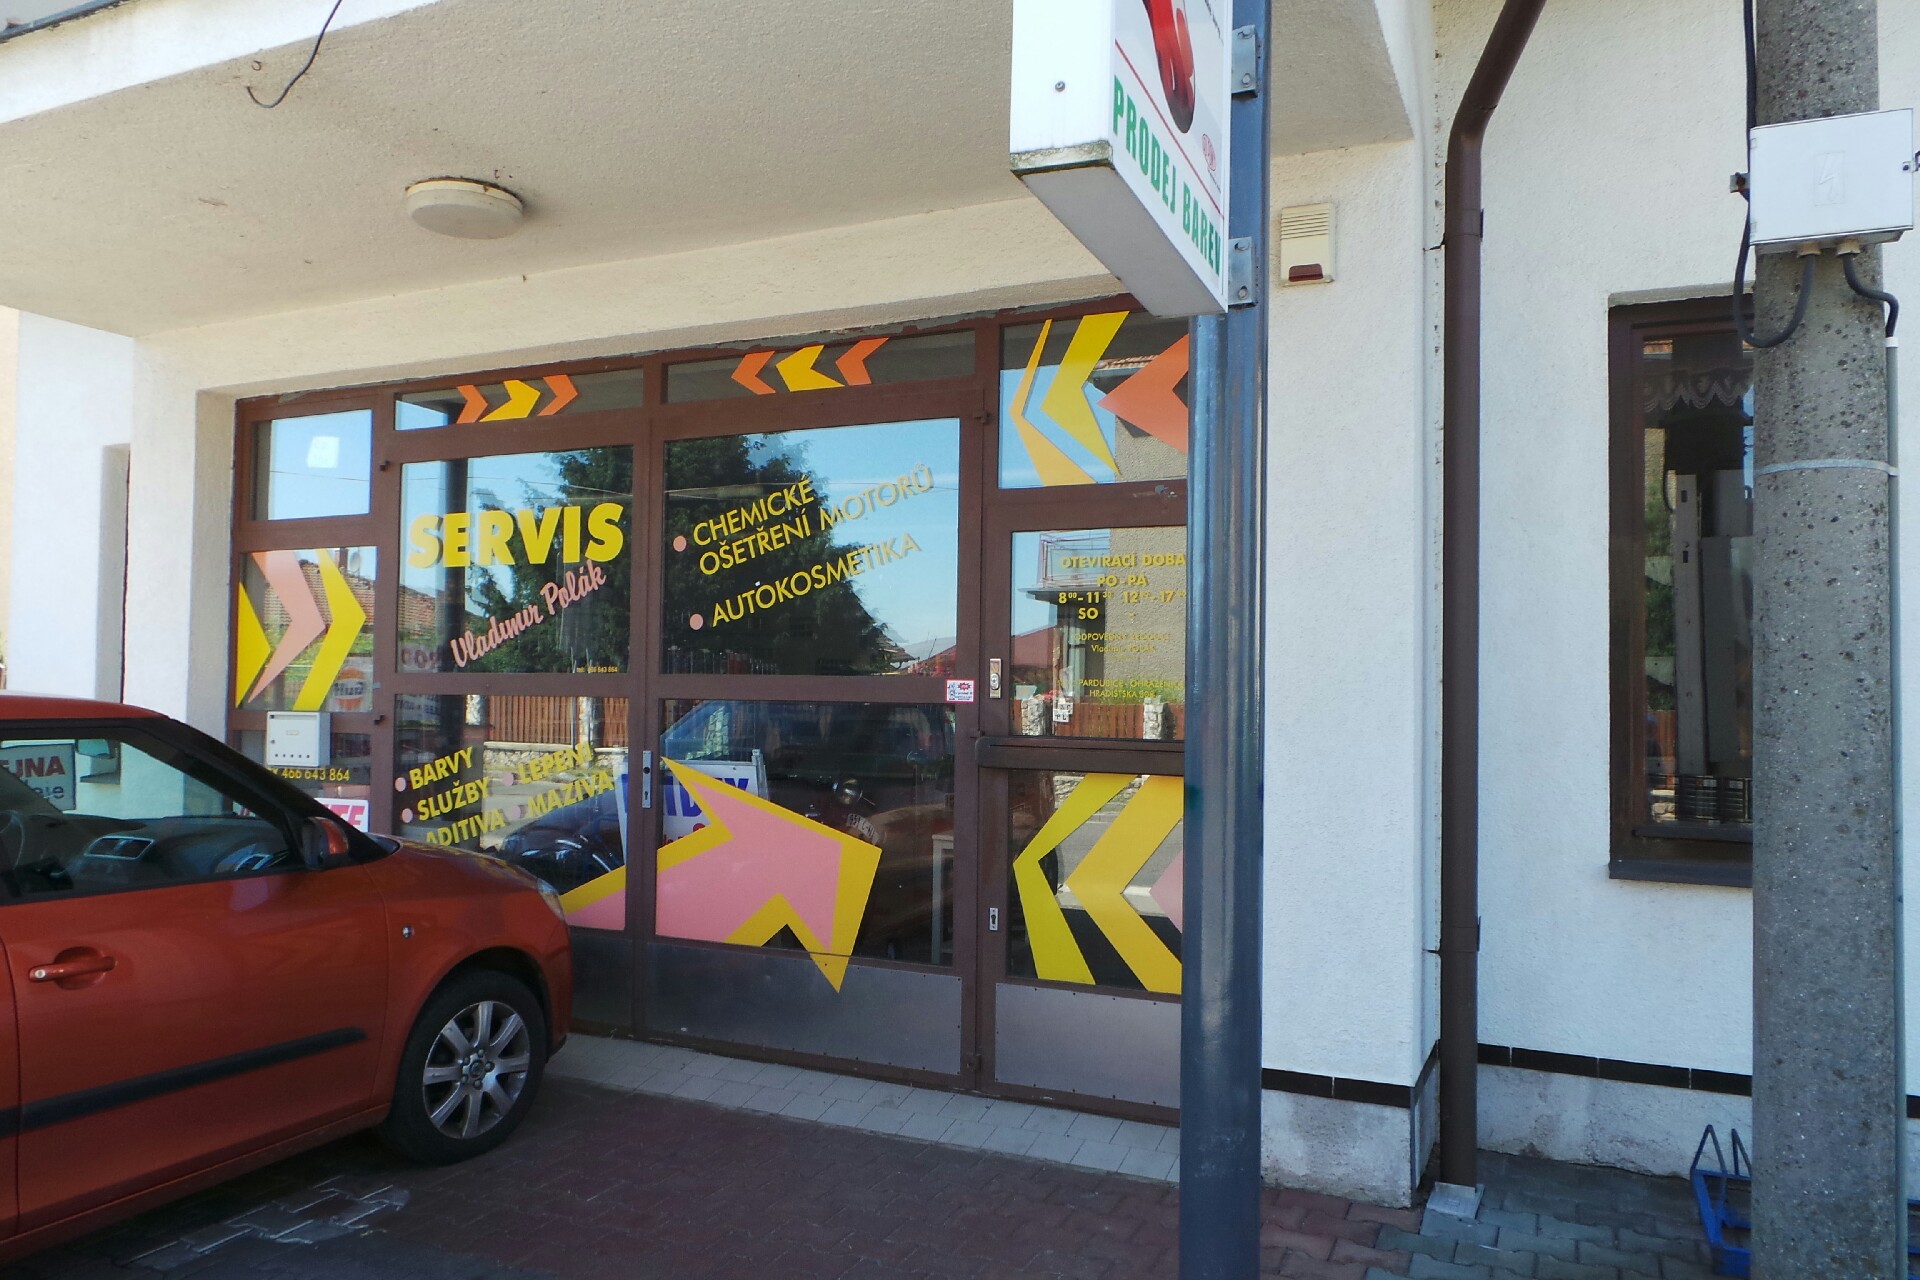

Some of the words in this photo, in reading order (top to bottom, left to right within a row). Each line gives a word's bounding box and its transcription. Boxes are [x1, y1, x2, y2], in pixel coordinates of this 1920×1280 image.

[1112, 75, 1176, 214] PRODEJ
[1182, 182, 1222, 276] BAREV
[692, 474, 815, 546] CHEMICKÉ
[698, 509, 811, 576] OŠETŘENÍ
[820, 463, 935, 531] MOTORŮ
[406, 502, 624, 569] SERVIS
[1141, 552, 1186, 567] DOBA
[540, 558, 607, 615] Polák
[710, 532, 922, 628] AUTOKOSMETIKA
[1078, 607, 1099, 620] SO
[329, 767, 350, 782] 864
[409, 746, 474, 790] BARVY
[417, 776, 490, 821] SLUŽBY
[527, 770, 615, 818] MAZIVA
[425, 807, 506, 847] ADITIVA
